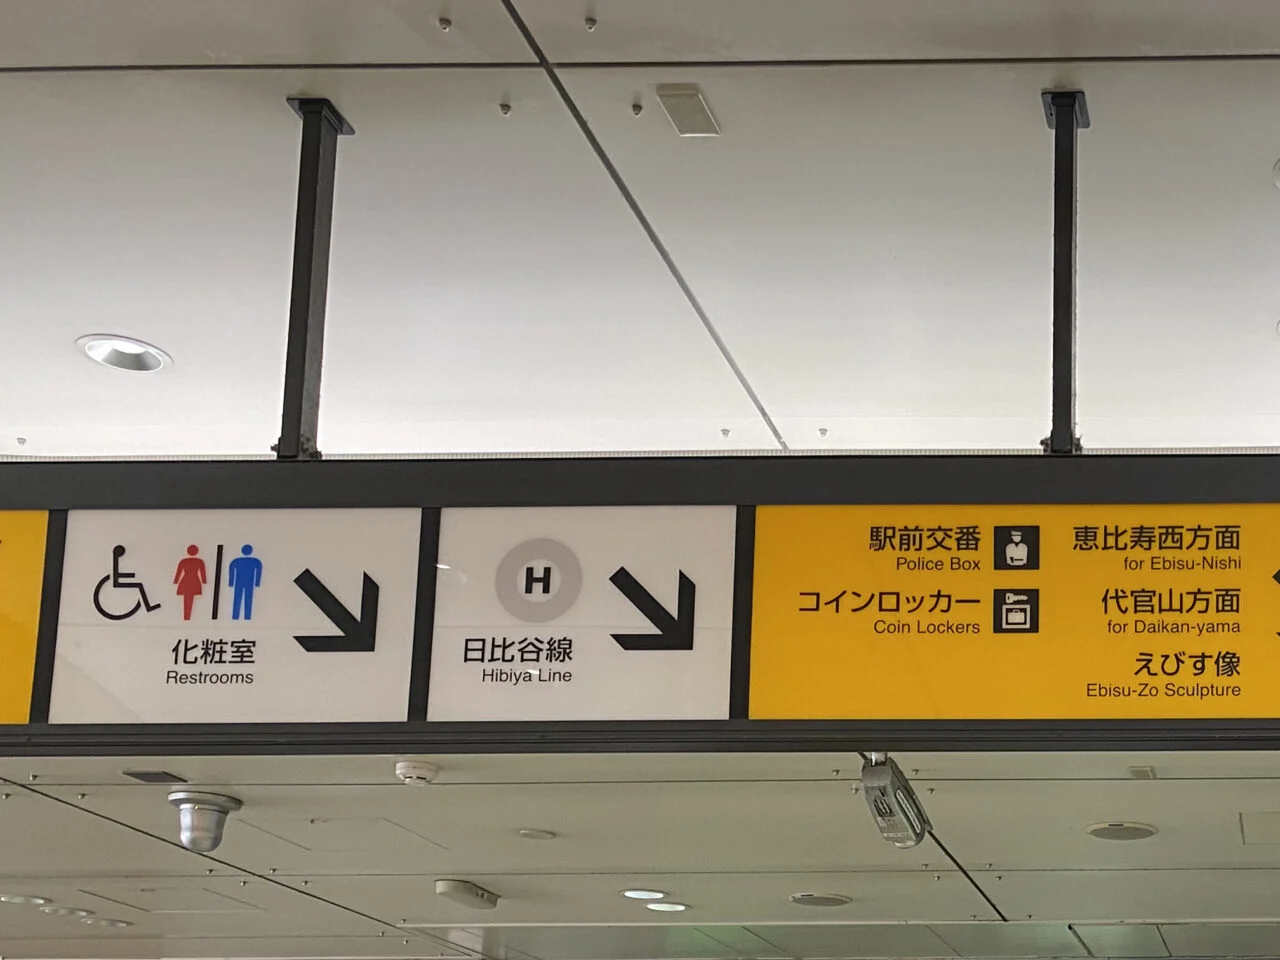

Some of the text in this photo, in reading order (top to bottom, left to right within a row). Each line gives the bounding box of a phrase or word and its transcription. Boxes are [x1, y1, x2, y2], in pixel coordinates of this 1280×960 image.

[869, 525, 981, 551] 駅前交番
[1073, 525, 1240, 551] 恵比寿西方面
[896, 556, 981, 571] Police Box
[1124, 556, 1241, 570] for Ebisu-Nishi
[525, 568, 551, 594] H
[798, 590, 981, 614] コインロッカー
[1101, 588, 1240, 615] 代官山方面
[874, 620, 981, 634] Coin Lockers
[1107, 620, 1241, 637] for Daikan-yama
[172, 638, 256, 665] 化粧室
[463, 637, 573, 664] 日比谷線
[1134, 652, 1241, 677] えびす像
[166, 669, 254, 685] Restrooms
[481, 668, 572, 686] Hibiya Line
[1087, 683, 1241, 700] Ebisu-Zo Sculpture
